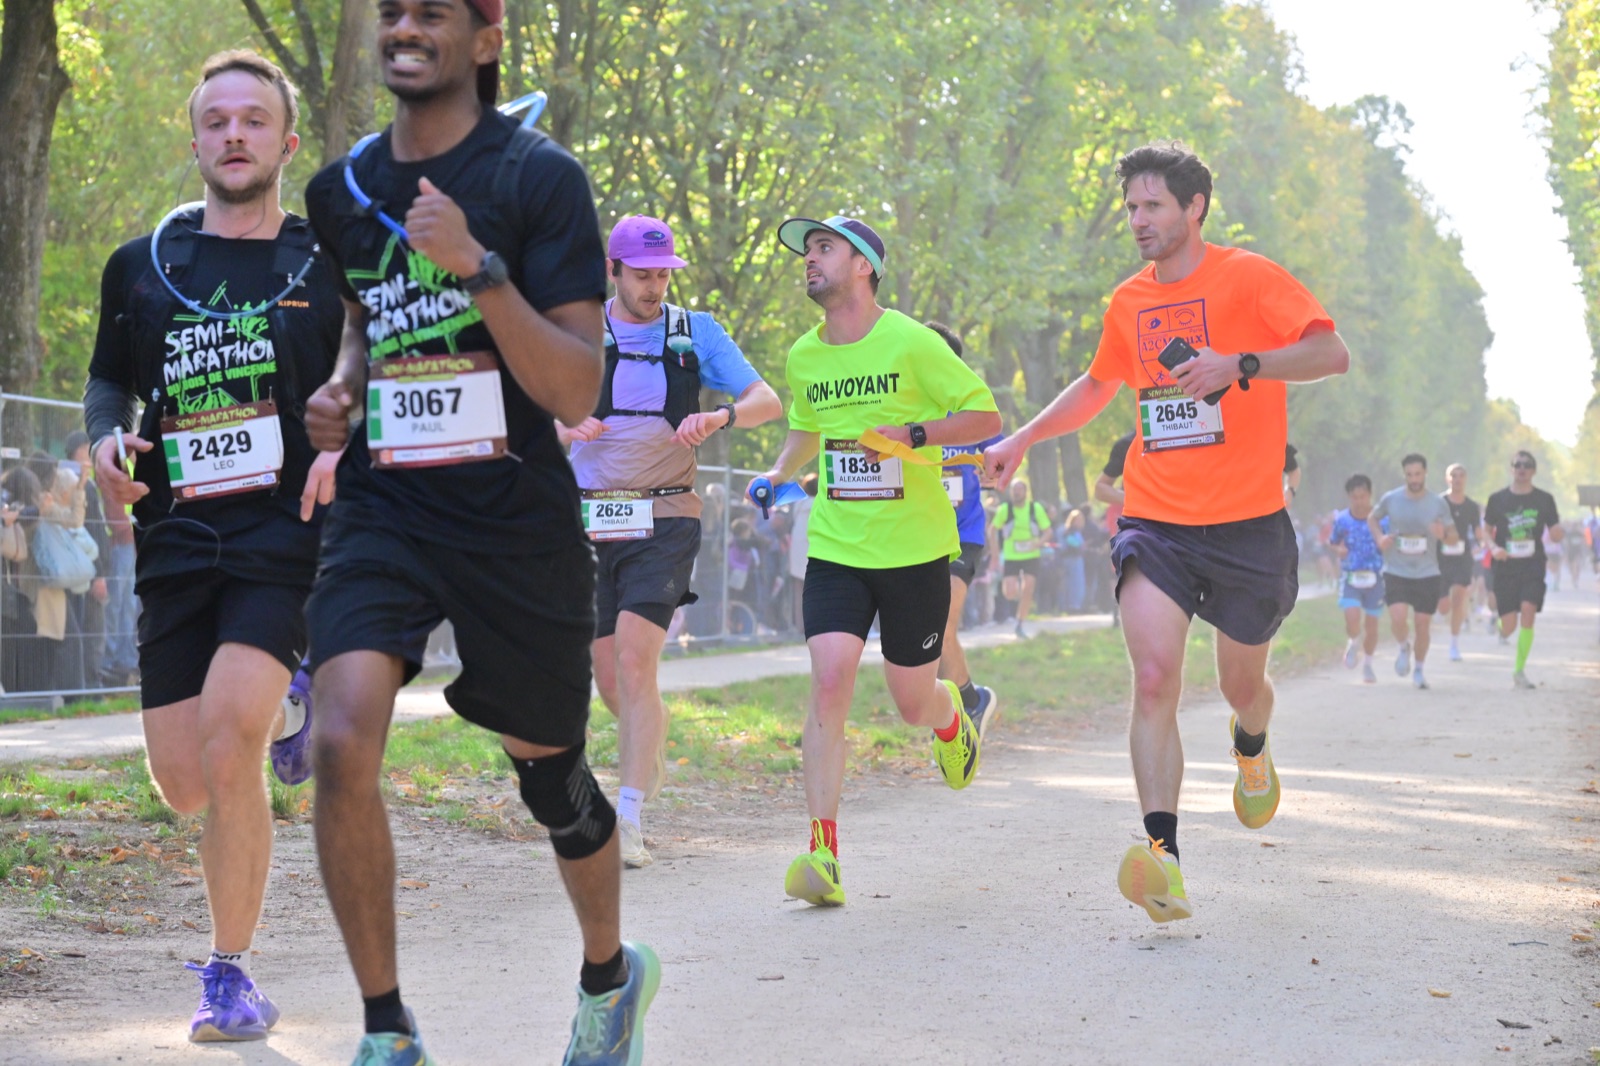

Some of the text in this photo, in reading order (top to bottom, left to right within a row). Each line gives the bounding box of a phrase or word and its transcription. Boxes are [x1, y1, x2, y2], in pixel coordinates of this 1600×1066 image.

[165, 321, 235, 358] SEMI-
[163, 340, 275, 385] MARATHON
[166, 385, 180, 397] DU
[182, 375, 206, 391] BOIS
[208, 371, 223, 384] DE
[806, 372, 900, 405] NON-VOYANT
[393, 387, 462, 419] 3067
[1155, 401, 1198, 423] 2645
[175, 407, 258, 430] SEMI-MARATHON
[411, 422, 446, 433] PAUL
[1161, 421, 1194, 432] THIBAUT
[189, 430, 252, 462] 2429
[213, 459, 235, 471] LEO
[839, 457, 882, 474] 1838
[839, 475, 882, 483] ALEXANDRE
[596, 503, 634, 518] 2625
[601, 518, 629, 526] THIBAUT
